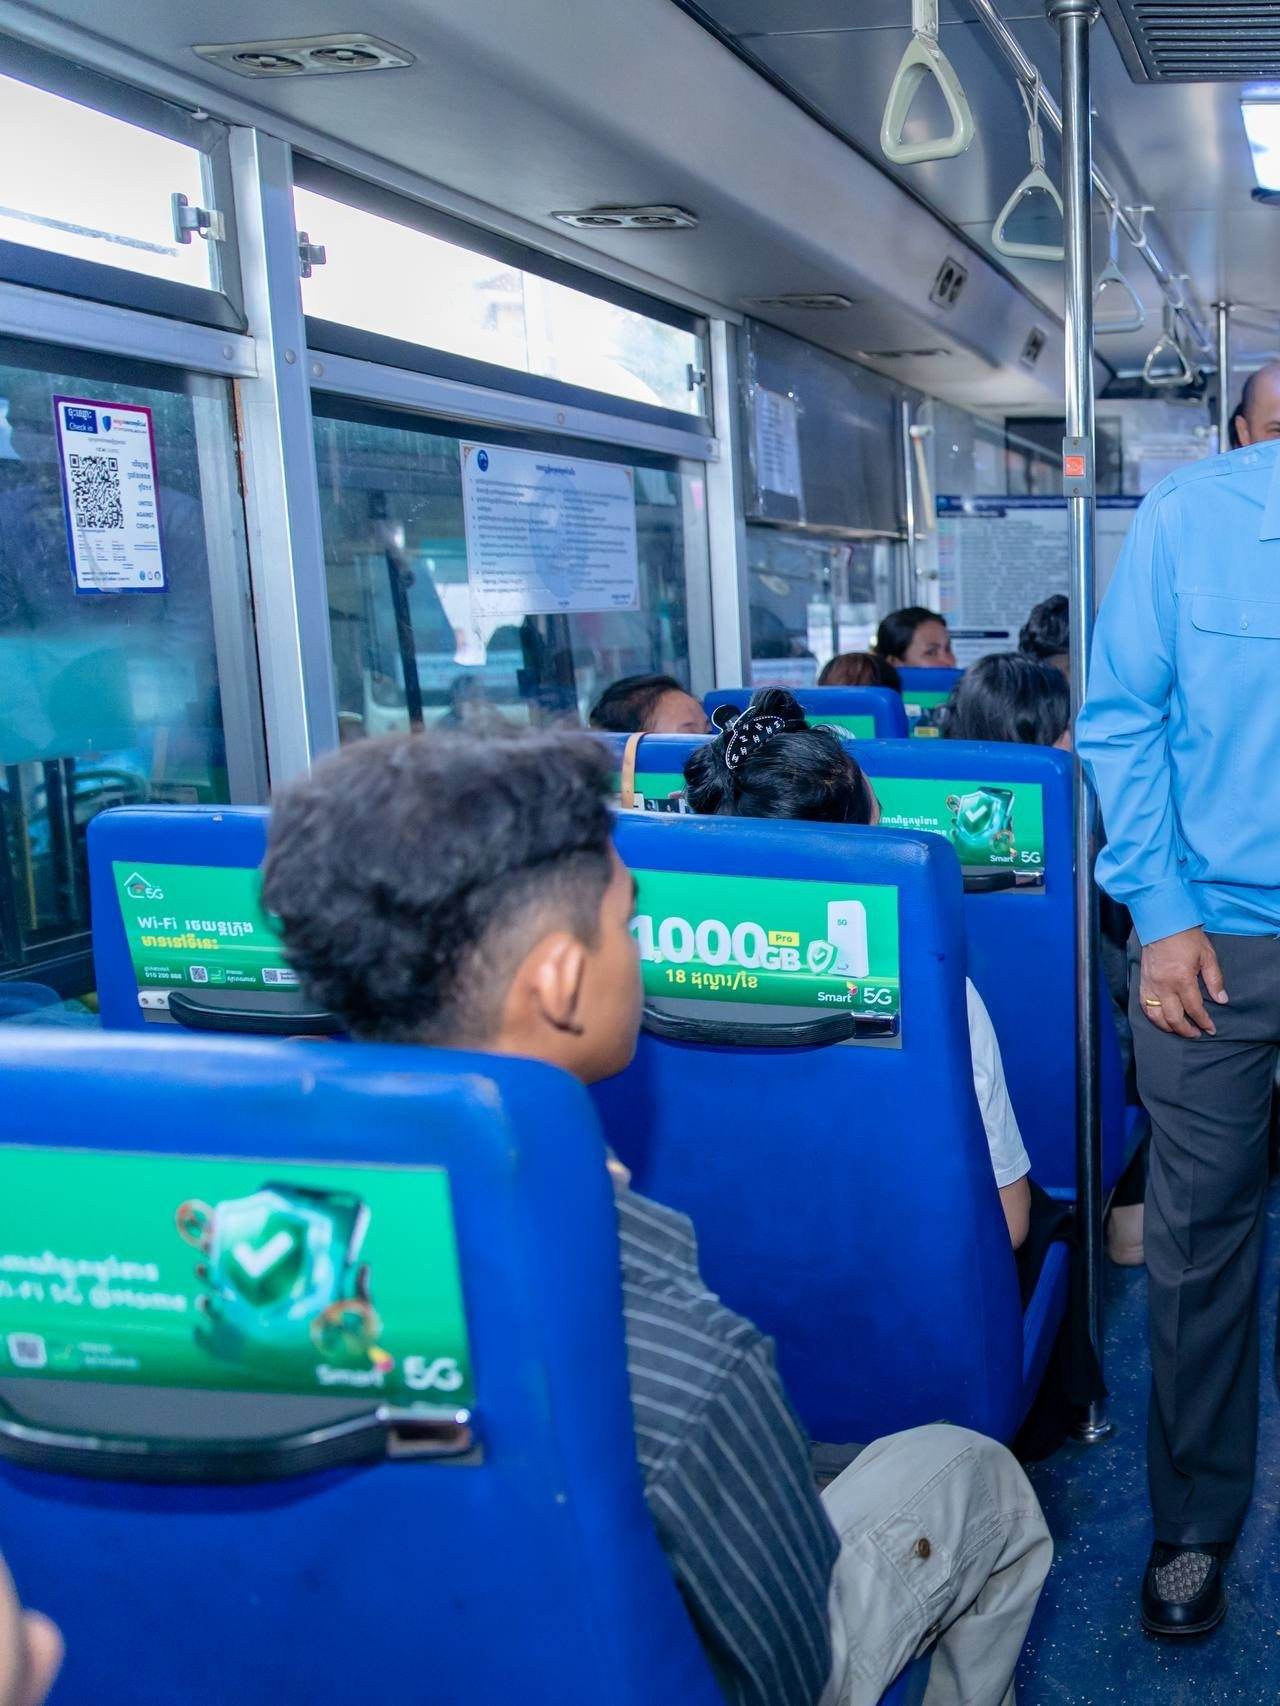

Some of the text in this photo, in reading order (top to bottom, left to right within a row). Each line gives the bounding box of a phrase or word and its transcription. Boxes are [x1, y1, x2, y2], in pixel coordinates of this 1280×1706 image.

[69, 422, 87, 431] Check
[990, 851, 1041, 863] Smart 5G
[145, 888, 164, 899] 5G
[137, 916, 177, 930] Wi-Fi
[776, 935, 793, 943] Pro
[757, 946, 801, 971] GB
[666, 968, 686, 983] 18
[817, 988, 892, 1005] Smart 5G
[403, 1355, 463, 1391] 5G
